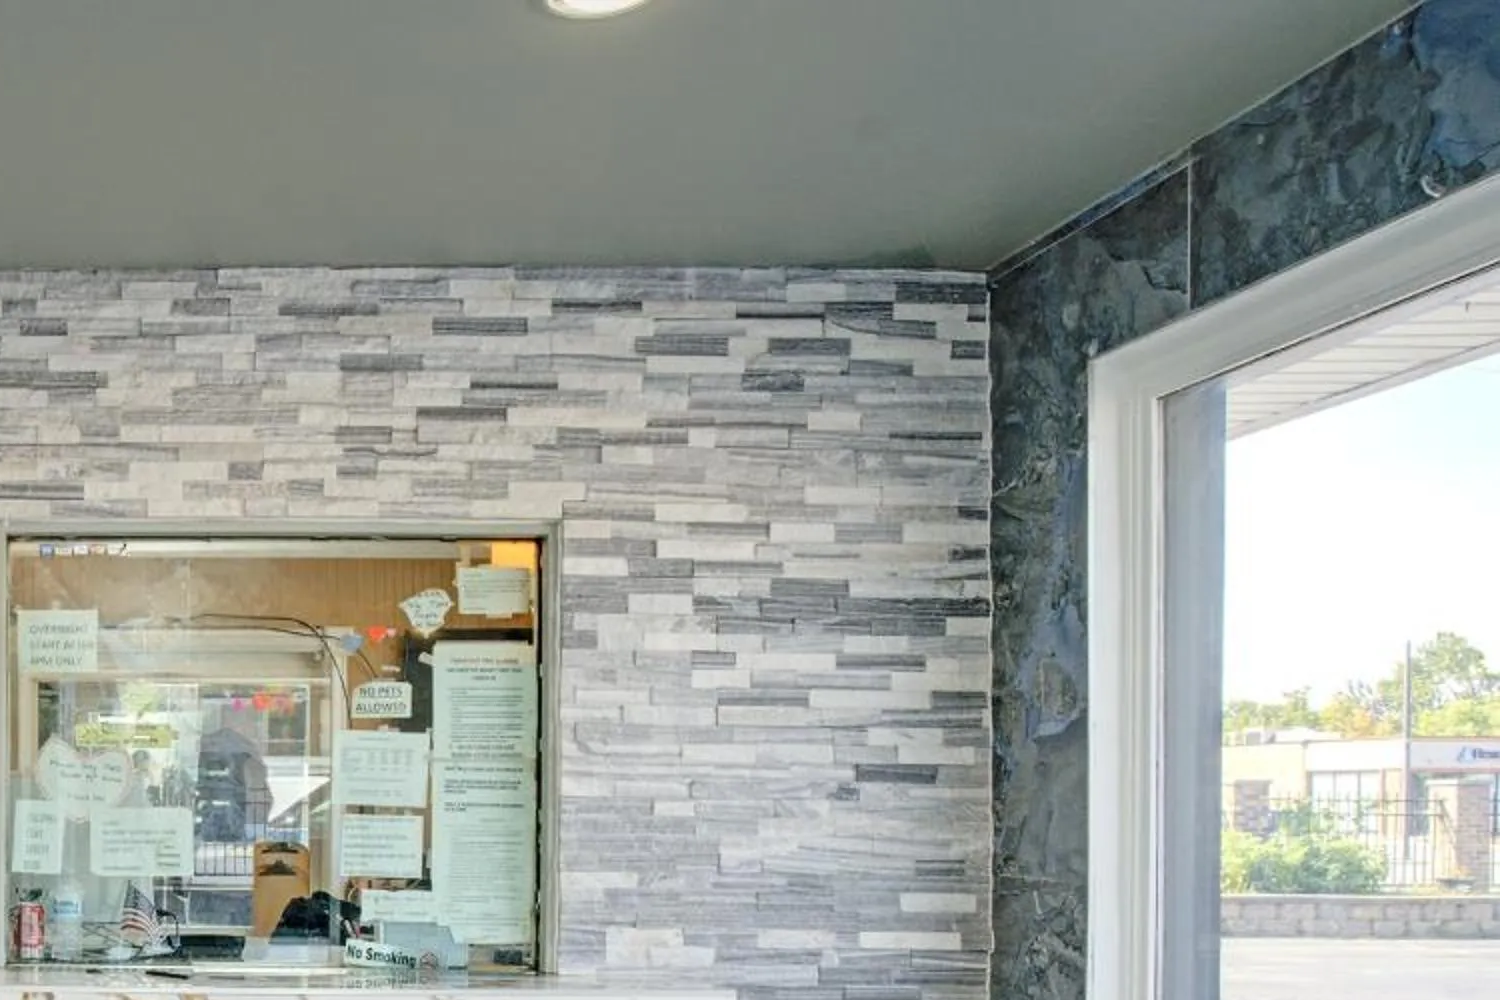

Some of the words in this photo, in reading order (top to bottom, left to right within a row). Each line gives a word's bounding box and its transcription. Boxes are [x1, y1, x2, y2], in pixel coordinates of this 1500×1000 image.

[359, 687, 376, 697] NO
[378, 686, 403, 698] PETS
[355, 703, 407, 713] ALLOWED
[347, 945, 362, 959] No
[365, 947, 417, 969] Smoking
